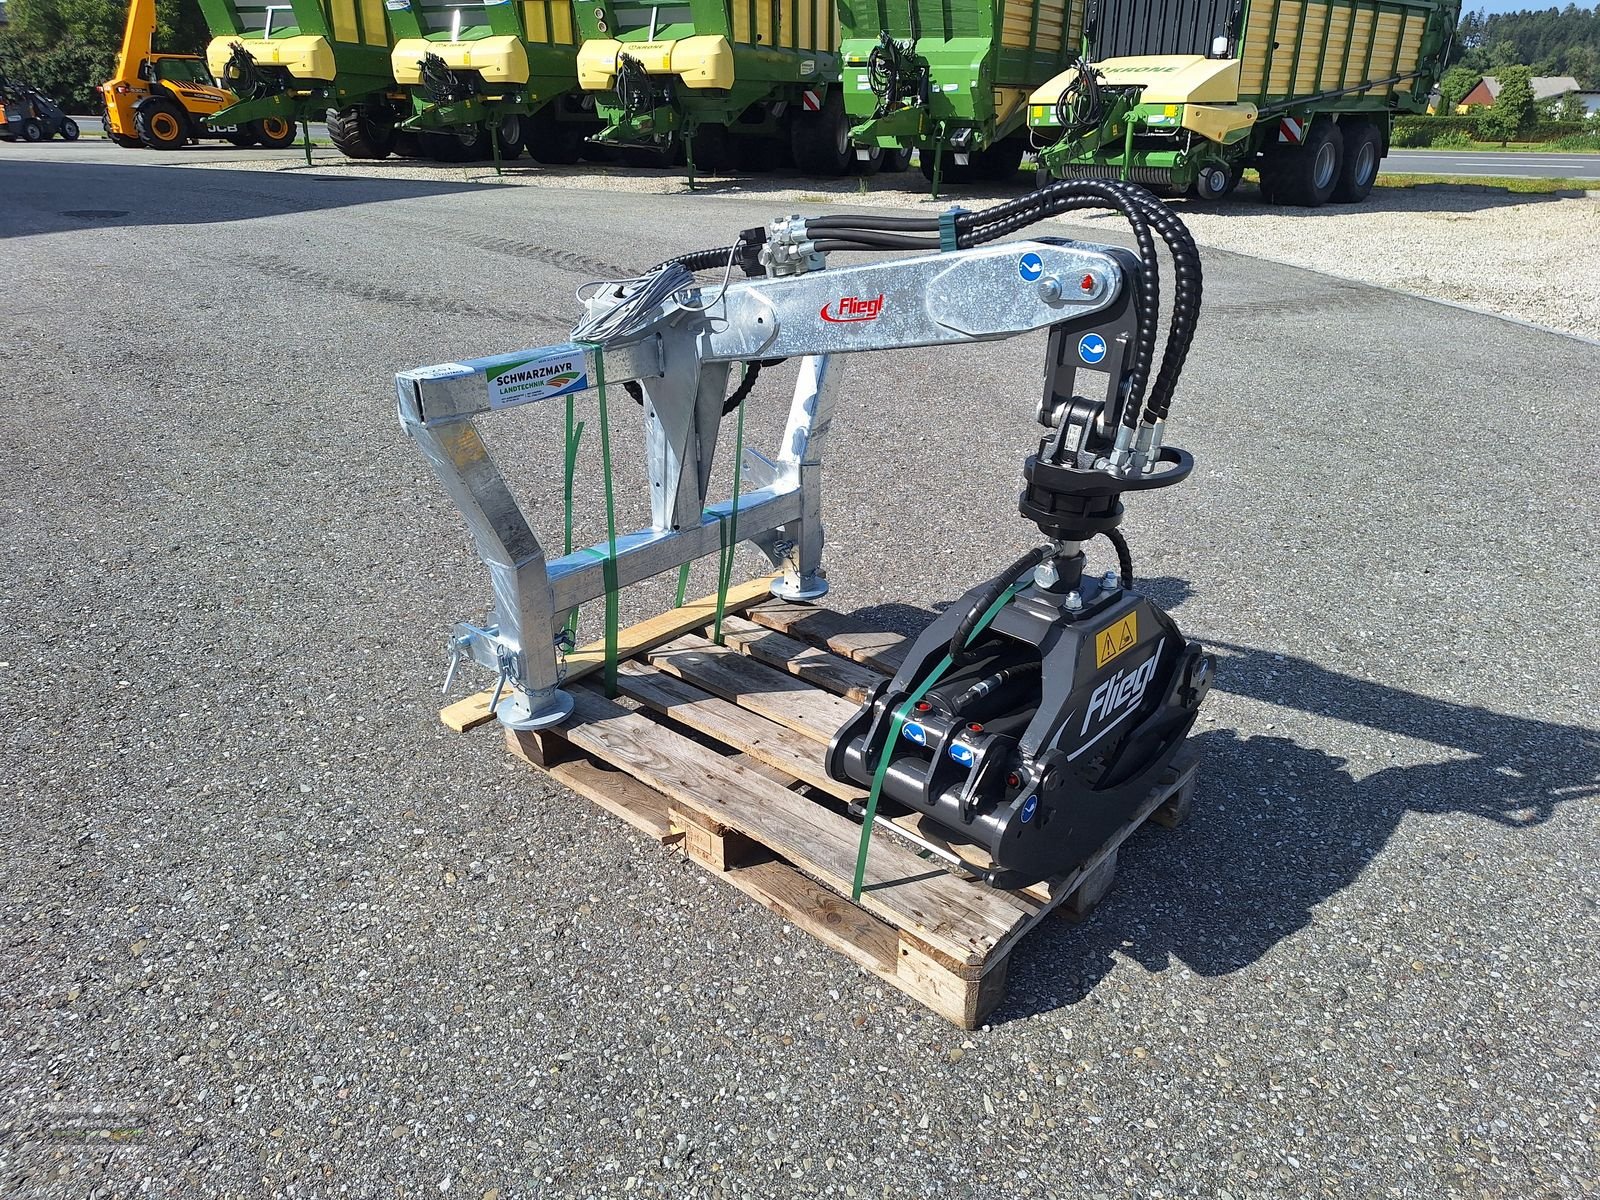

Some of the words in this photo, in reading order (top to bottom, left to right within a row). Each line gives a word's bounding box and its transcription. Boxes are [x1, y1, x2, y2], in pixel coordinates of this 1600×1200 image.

[207, 124, 238, 132] JCB
[839, 294, 884, 317] Fliegl
[496, 362, 572, 386] SCHWARZMAYR
[499, 380, 545, 395] LANDTECHNIK
[1080, 636, 1166, 737] Fliegl
